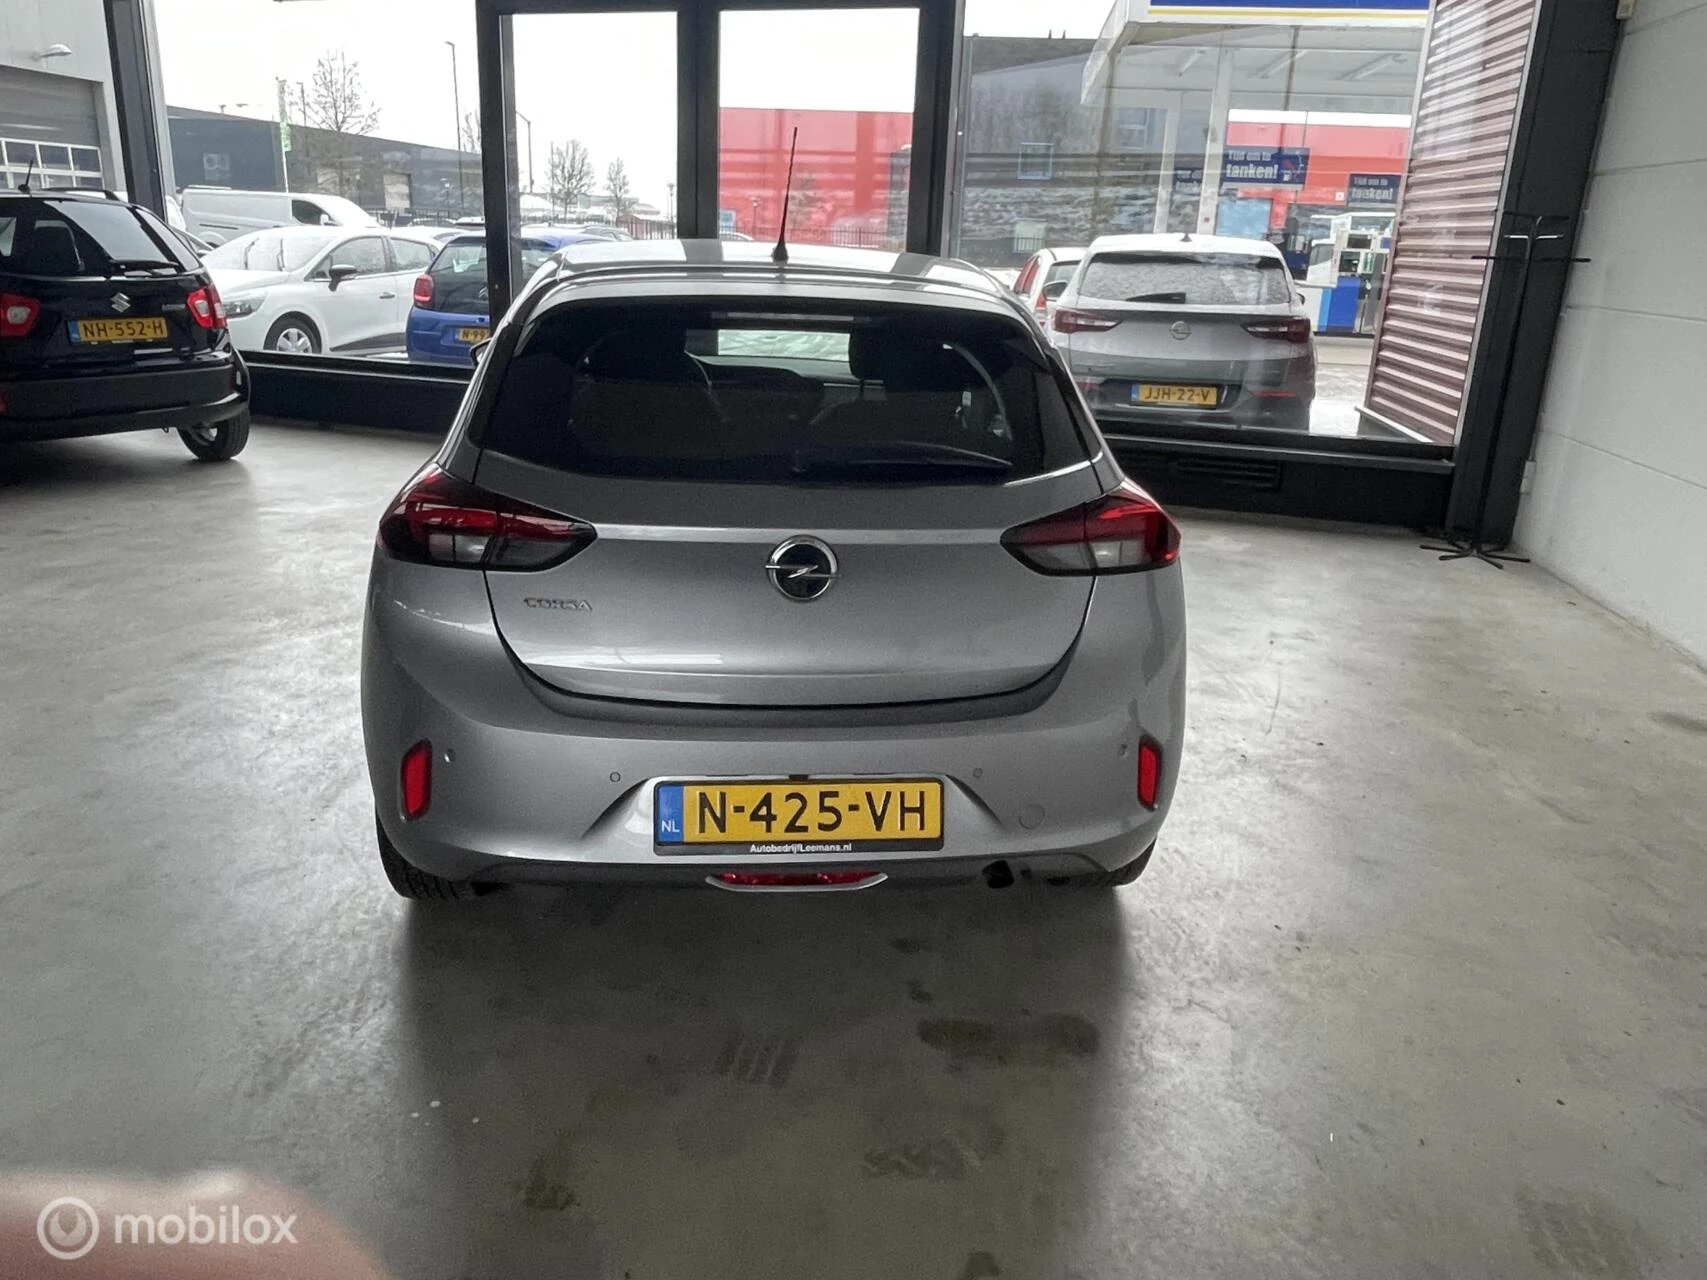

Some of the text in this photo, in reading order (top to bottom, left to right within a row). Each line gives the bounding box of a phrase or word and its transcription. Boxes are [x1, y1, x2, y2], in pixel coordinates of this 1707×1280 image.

[1226, 163, 1279, 179] tanken!
[83, 320, 164, 338] NH-552-H
[1144, 387, 1210, 402] JJH-22-V
[698, 790, 926, 834] N-425-VH
[661, 820, 680, 833] NL
[750, 843, 852, 854] AutobedrijfLeemans.nl
